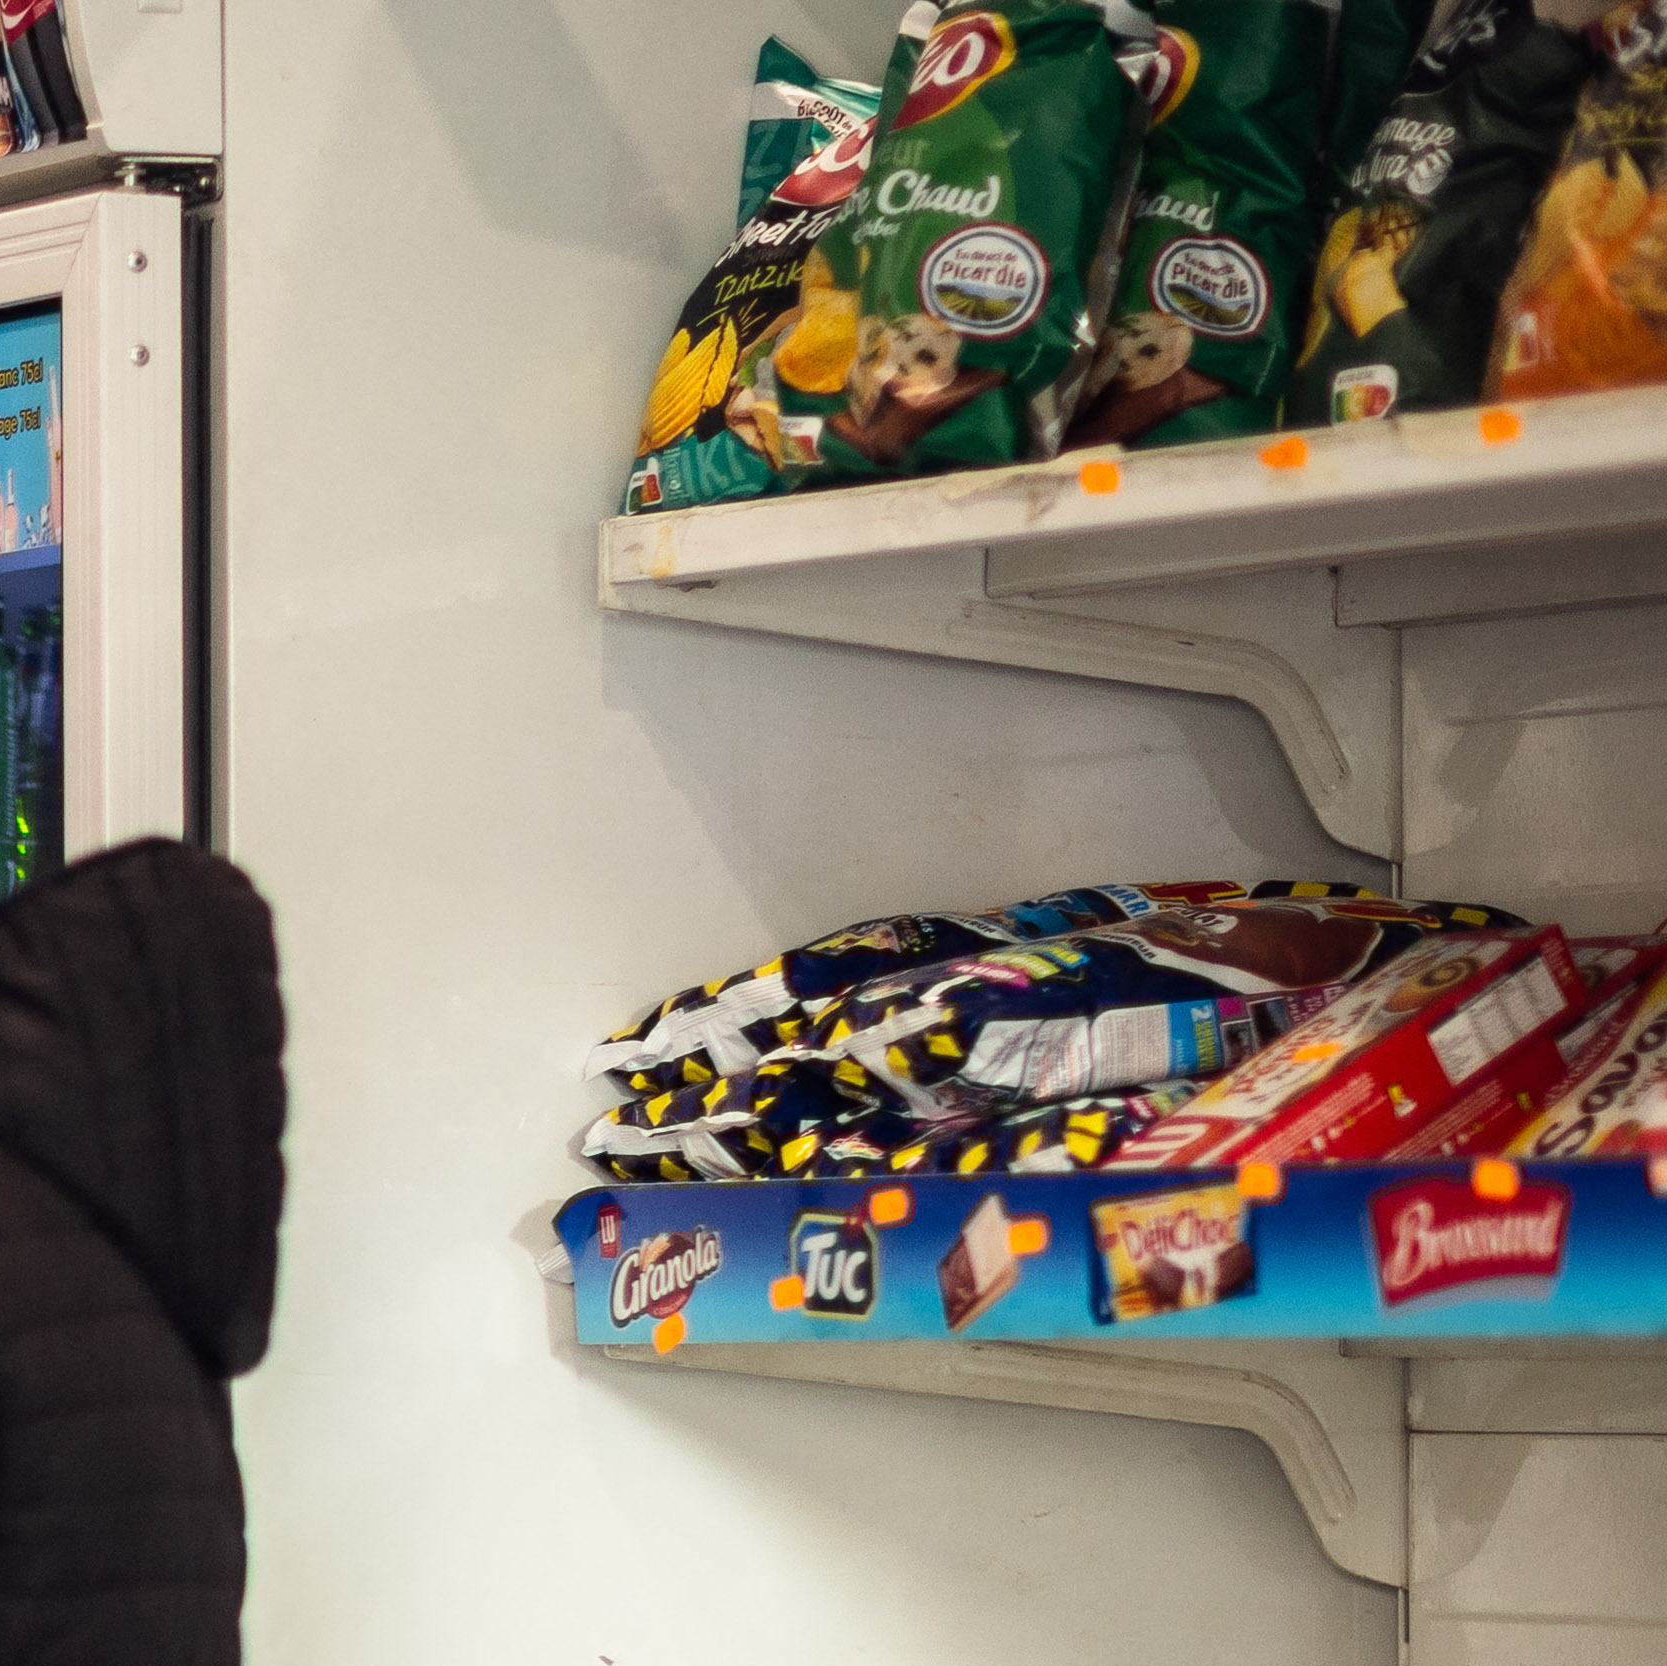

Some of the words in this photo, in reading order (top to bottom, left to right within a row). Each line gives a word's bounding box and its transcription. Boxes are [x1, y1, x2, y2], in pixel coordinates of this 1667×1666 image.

[877, 169, 1001, 218] Chaud
[714, 260, 807, 306] Tzatzik
[938, 260, 1027, 289] Picardie
[1171, 261, 1249, 300] Picardie
[20, 357, 43, 385] 75cl
[19, 406, 42, 432] 75cl
[611, 1229, 720, 1322] Granola
